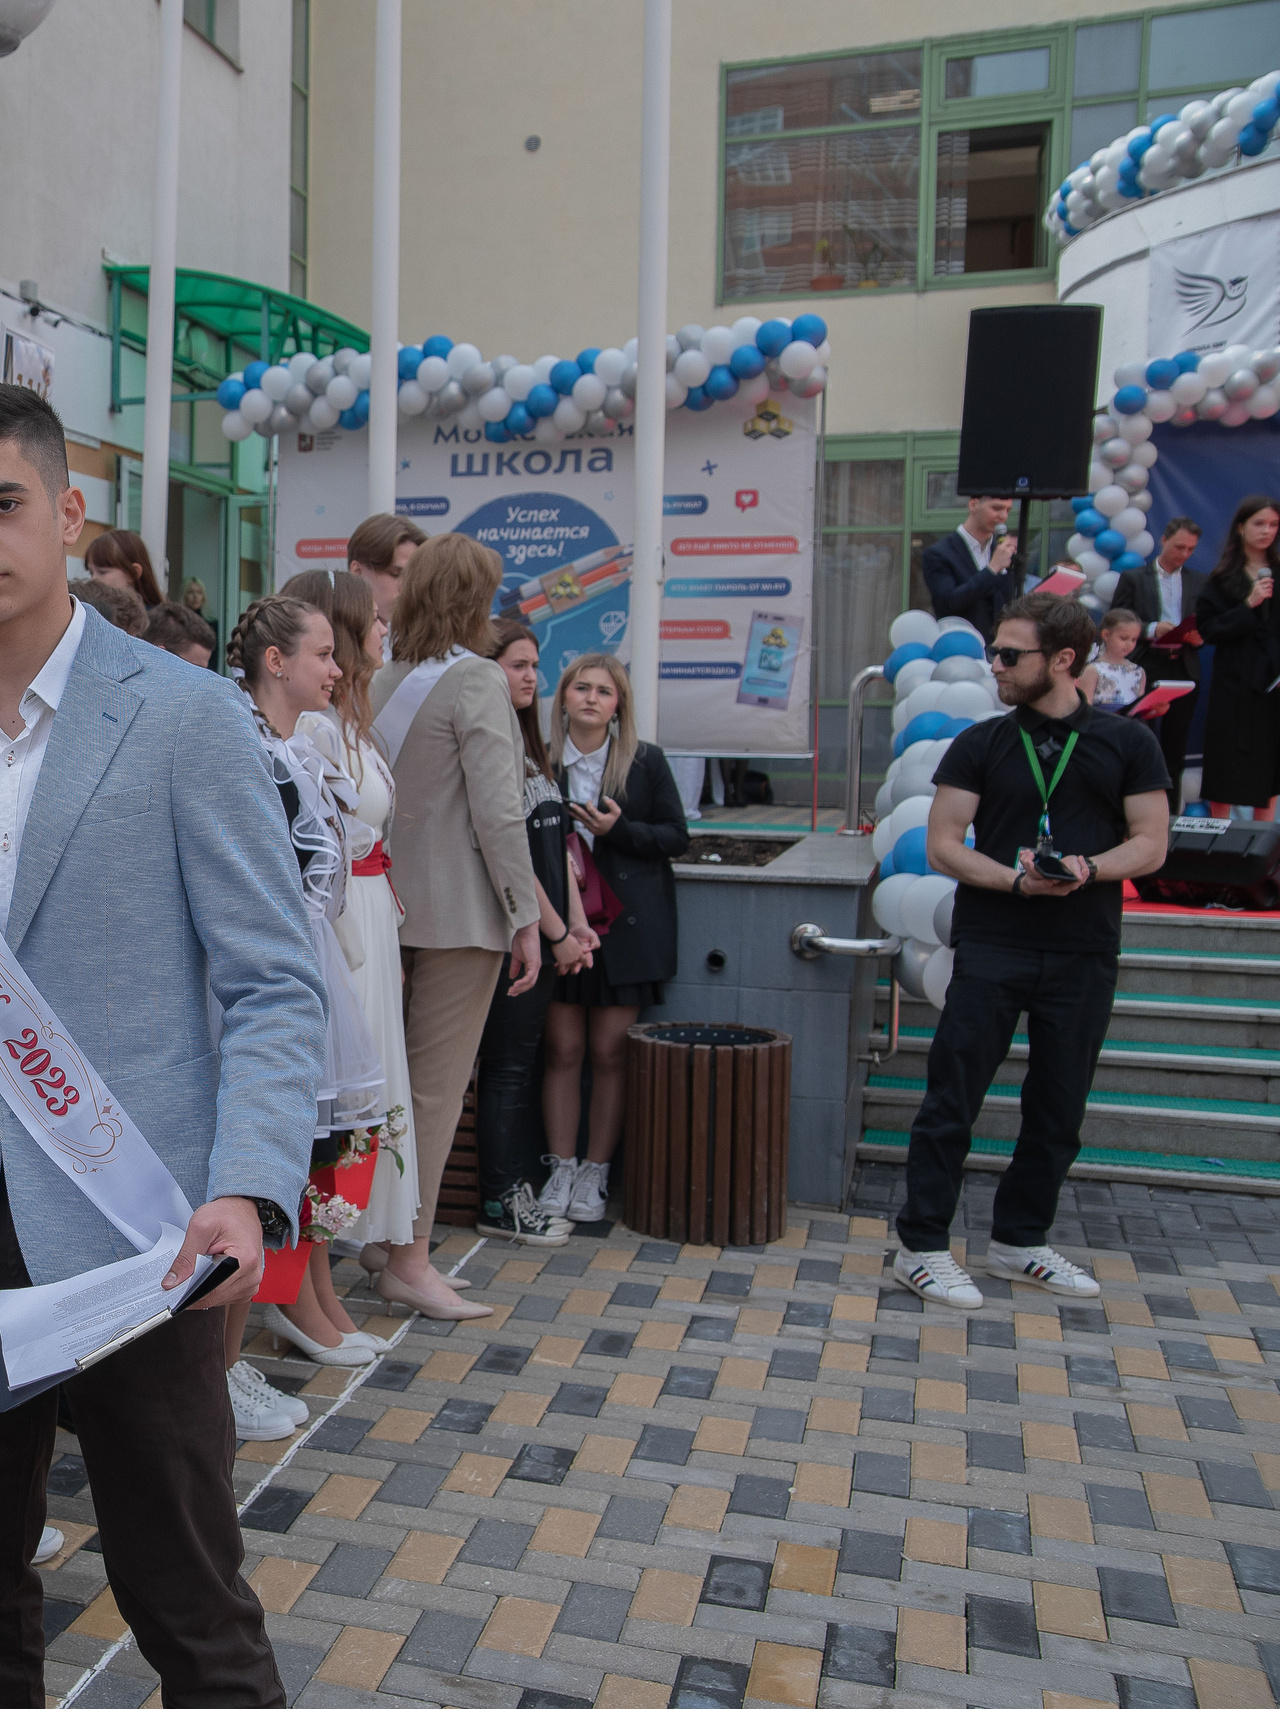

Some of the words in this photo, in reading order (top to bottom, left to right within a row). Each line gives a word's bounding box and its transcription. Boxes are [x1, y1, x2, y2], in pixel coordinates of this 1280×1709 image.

[450, 447, 614, 477] школа
[506, 506, 560, 524] Успех
[476, 525, 590, 542] начинается
[505, 541, 565, 565] здесь!
[2, 1028, 81, 1118] 2023
